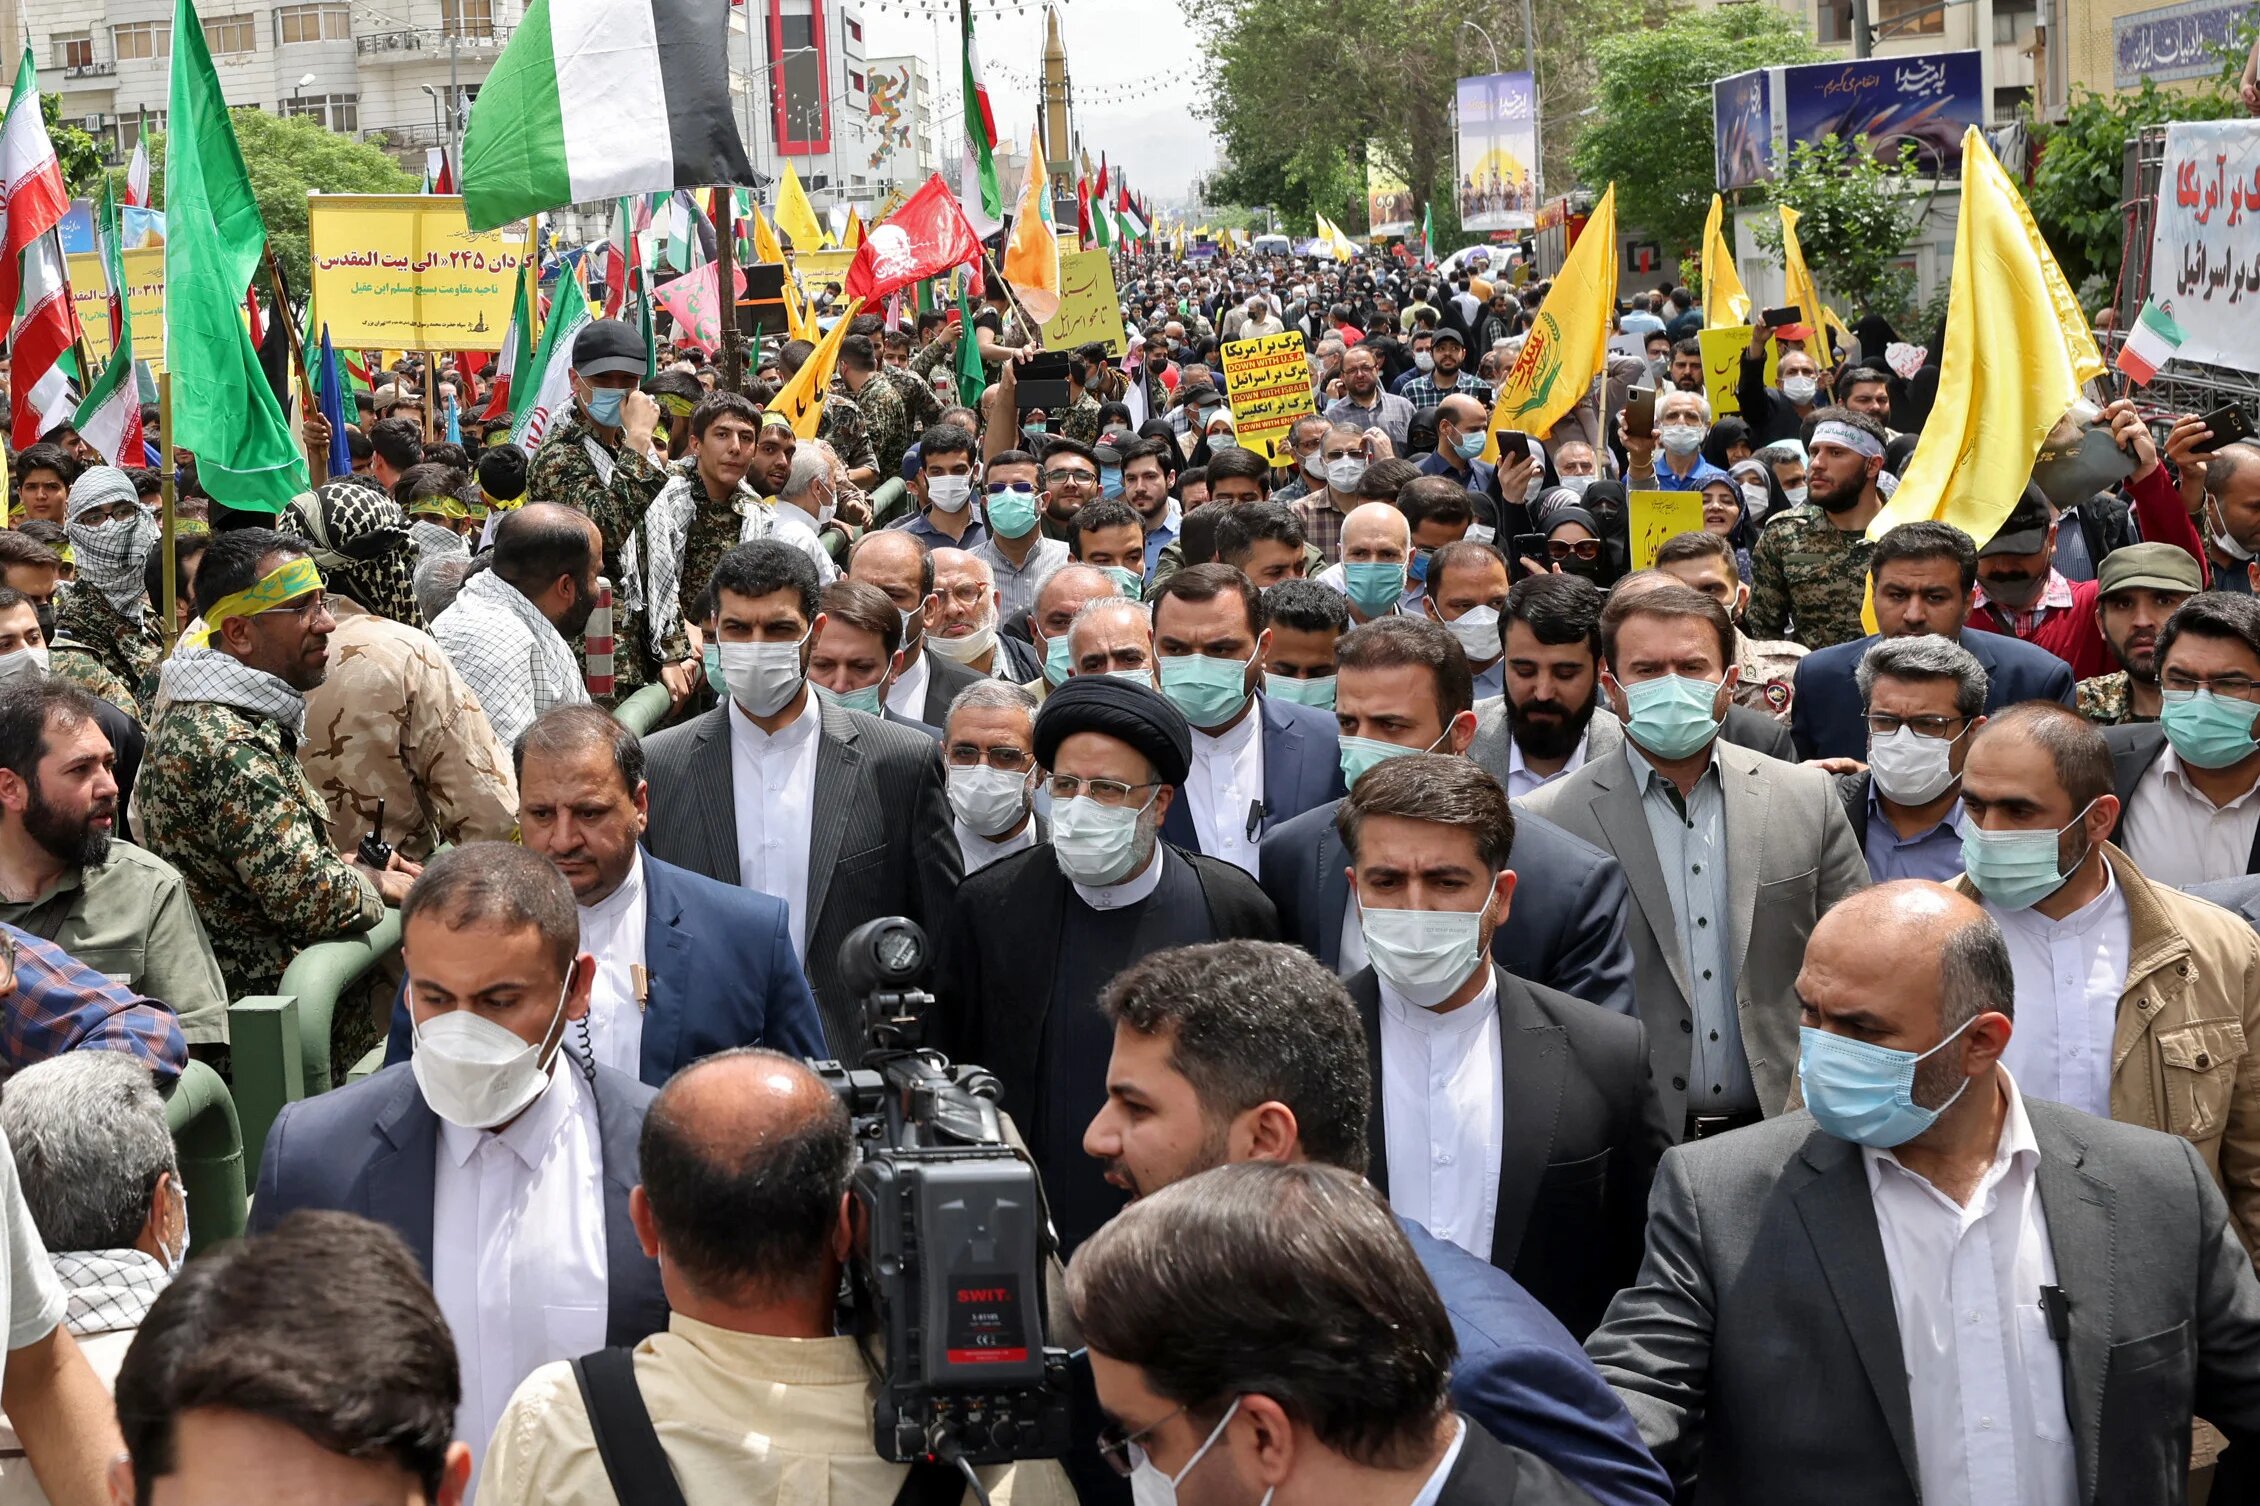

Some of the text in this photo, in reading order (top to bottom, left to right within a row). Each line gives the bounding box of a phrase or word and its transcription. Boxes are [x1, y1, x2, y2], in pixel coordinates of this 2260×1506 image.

[2176, 153, 2227, 226] آمریکا
[381, 254, 408, 272] بیت
[449, 250, 486, 270] ۲۴۵
[488, 252, 535, 273] گدان
[2176, 238, 2232, 302] اسرائیل
[350, 281, 499, 297] ناحیه مقاومت بسیج مسلم ابن عقیل
[1225, 335, 1304, 359] مرگ بر آمریکا
[1228, 361, 1256, 372] DOWN
[1256, 356, 1280, 367] WITH
[1231, 365, 1308, 390] مرگ بر اسرائیل
[1233, 383, 1308, 402] DOWN WITH ISRAEL
[1236, 401, 1272, 420] انگلیس
[1276, 402, 1285, 414] بر
[1238, 422, 1261, 432] DOWN
[1261, 419, 1279, 428] WITH
[957, 1288, 1006, 1302] SWIT
